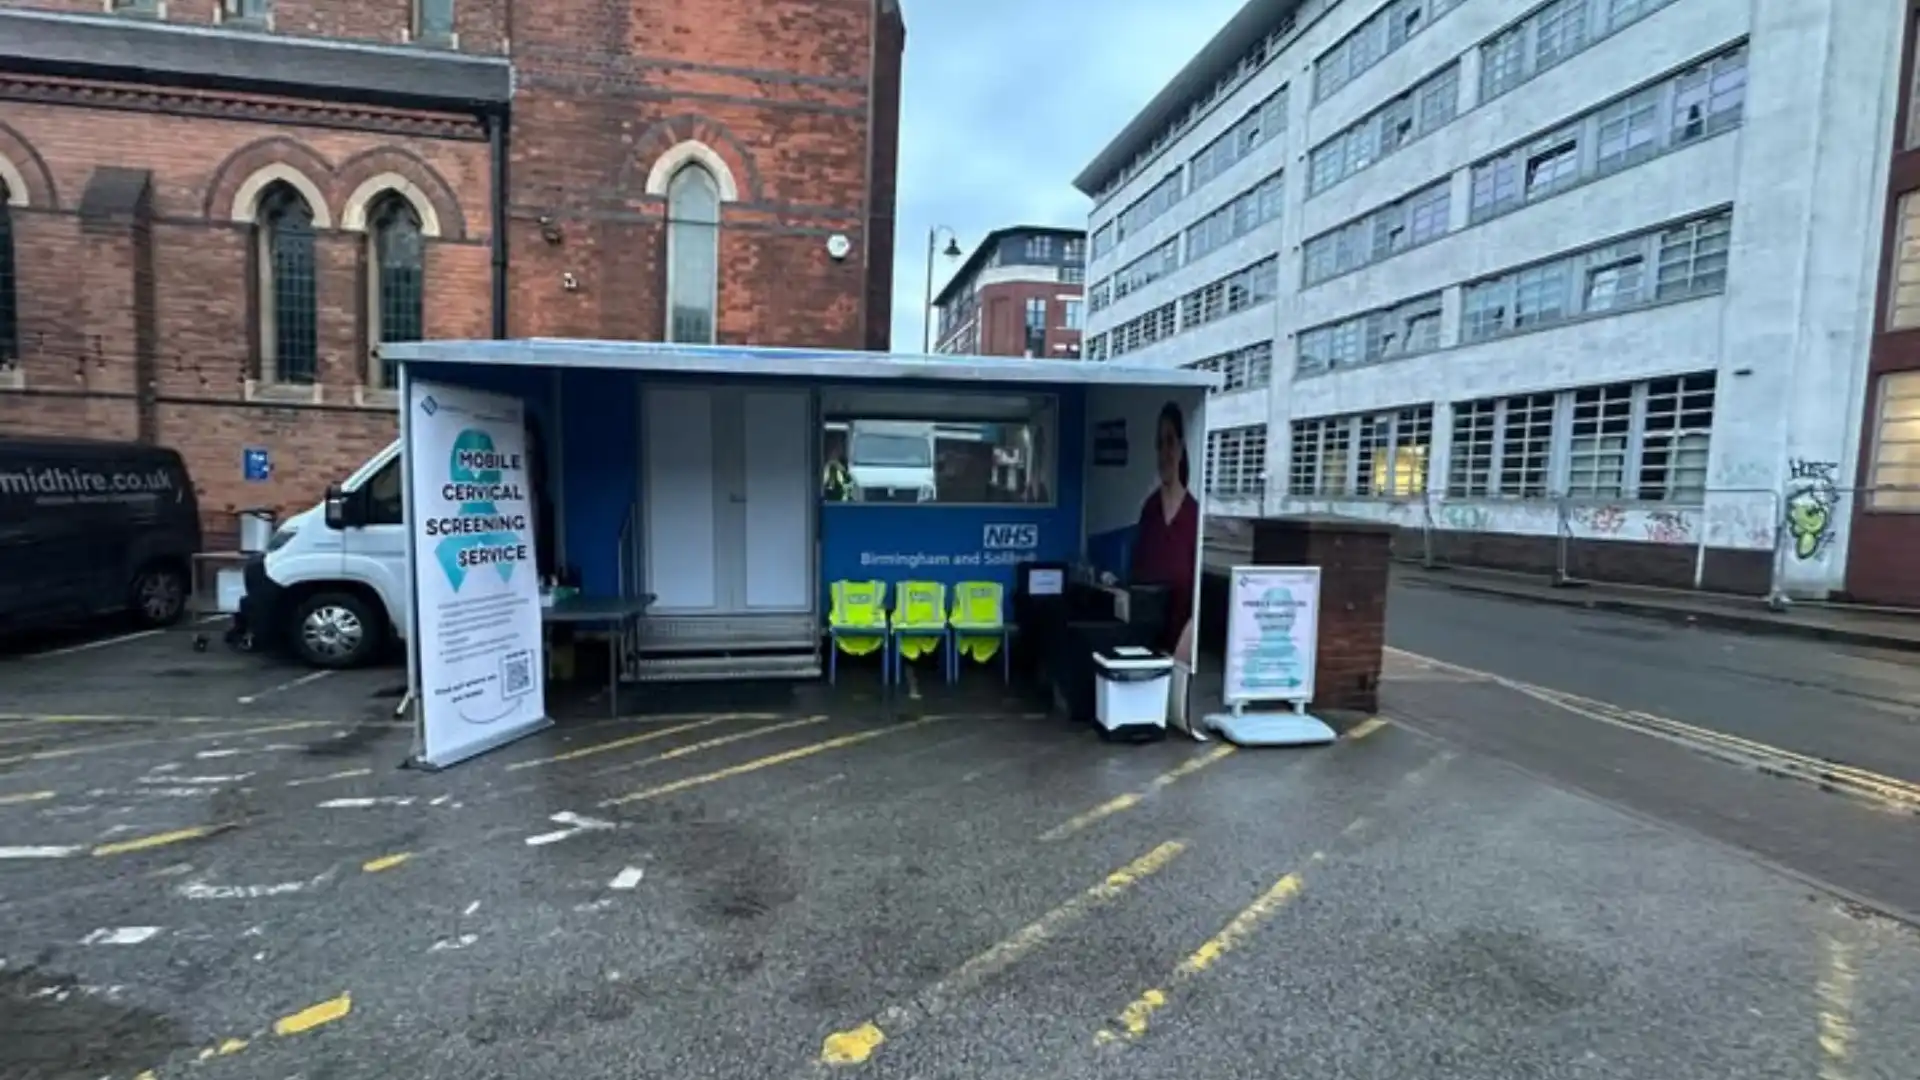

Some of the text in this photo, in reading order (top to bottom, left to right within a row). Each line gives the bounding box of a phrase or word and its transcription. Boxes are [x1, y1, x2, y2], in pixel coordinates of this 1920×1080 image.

[459, 451, 522, 470] MOBILE
[0, 467, 173, 493] midhire.co.uk
[441, 483, 525, 501] CERVICAL
[425, 515, 526, 536] SCREENING
[984, 524, 1038, 548] NHS
[457, 544, 528, 567] SERVICE
[860, 552, 950, 569] Birmingham
[953, 552, 980, 565] and
